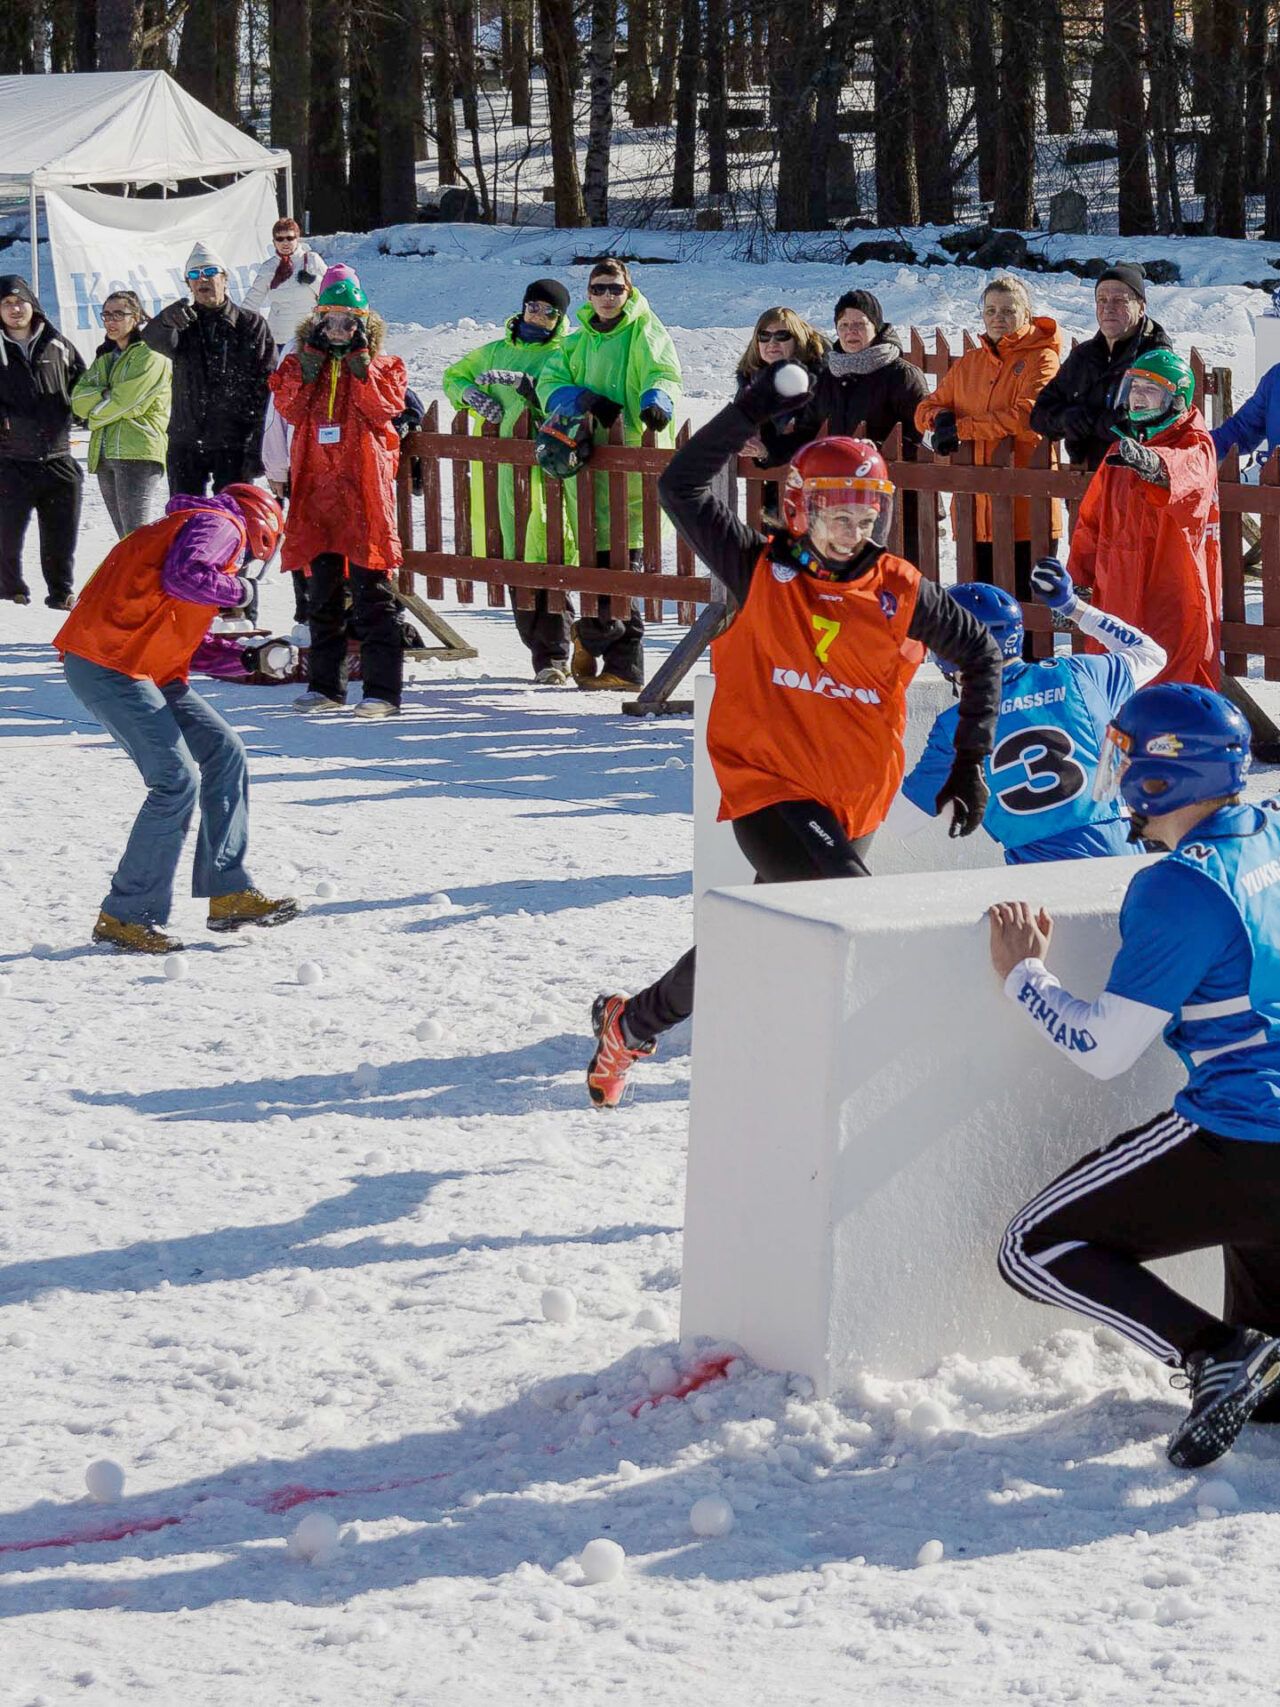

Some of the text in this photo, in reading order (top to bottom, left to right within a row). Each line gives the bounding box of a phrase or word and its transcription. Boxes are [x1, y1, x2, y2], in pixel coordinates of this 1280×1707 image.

[812, 615, 840, 662] 7
[990, 725, 1088, 815] 3
[1017, 981, 1098, 1052] FINLAND
